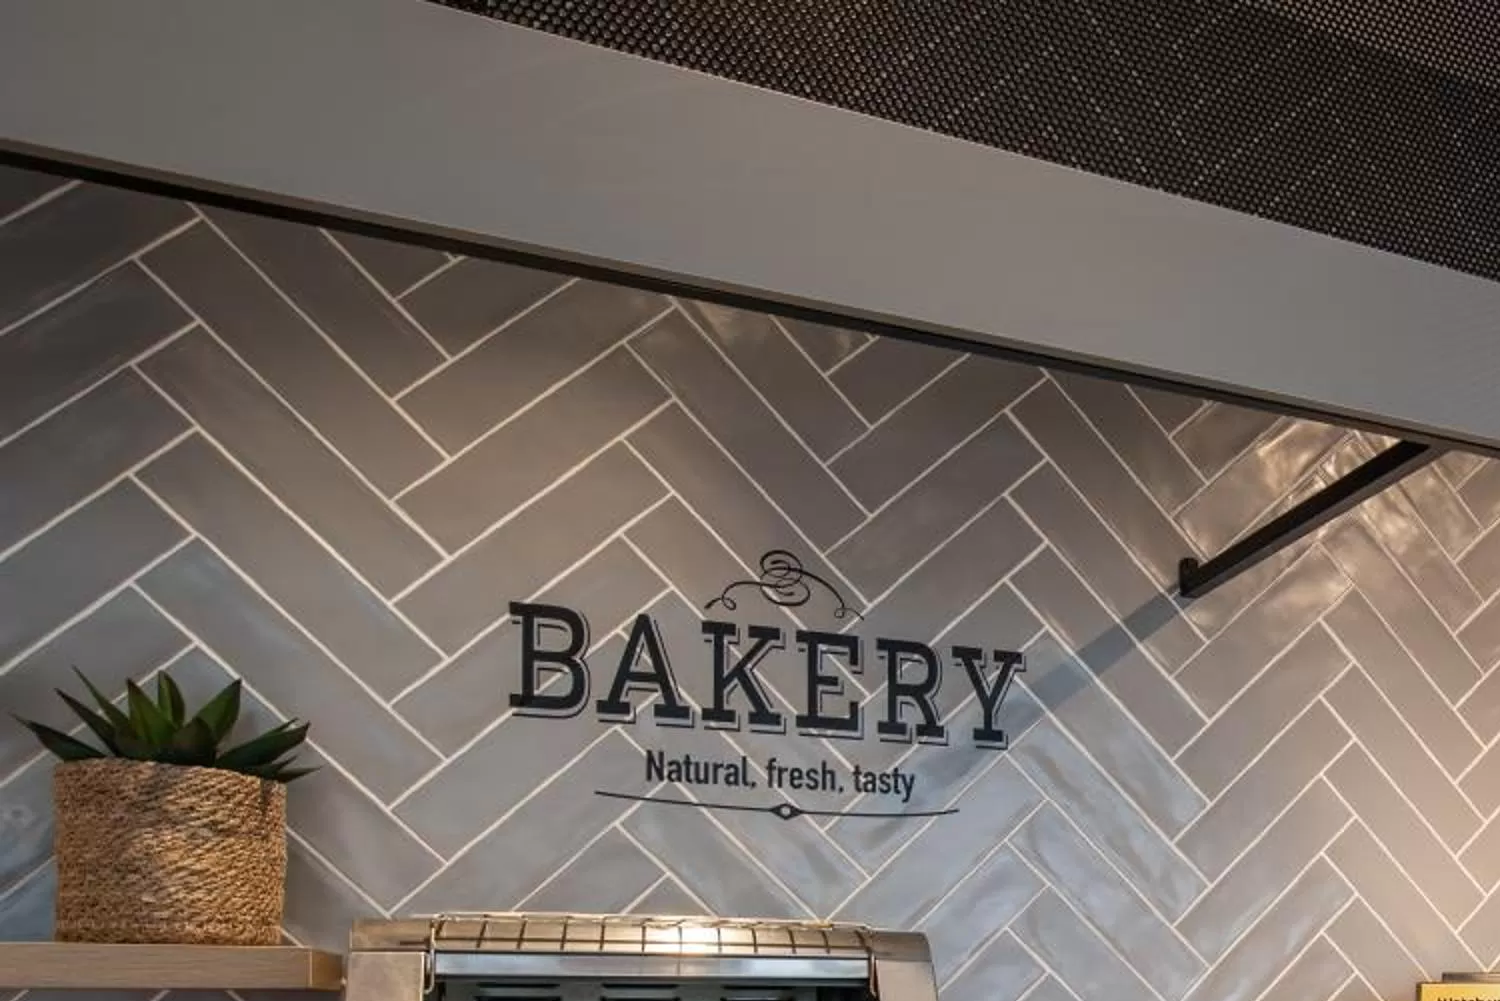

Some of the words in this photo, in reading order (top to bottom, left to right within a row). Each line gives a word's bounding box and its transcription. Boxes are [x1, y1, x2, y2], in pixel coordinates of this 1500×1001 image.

[509, 601, 1026, 750] BAKERY
[646, 749, 757, 788] Natural,
[766, 757, 844, 793] fresh,
[853, 764, 916, 803] tasty
